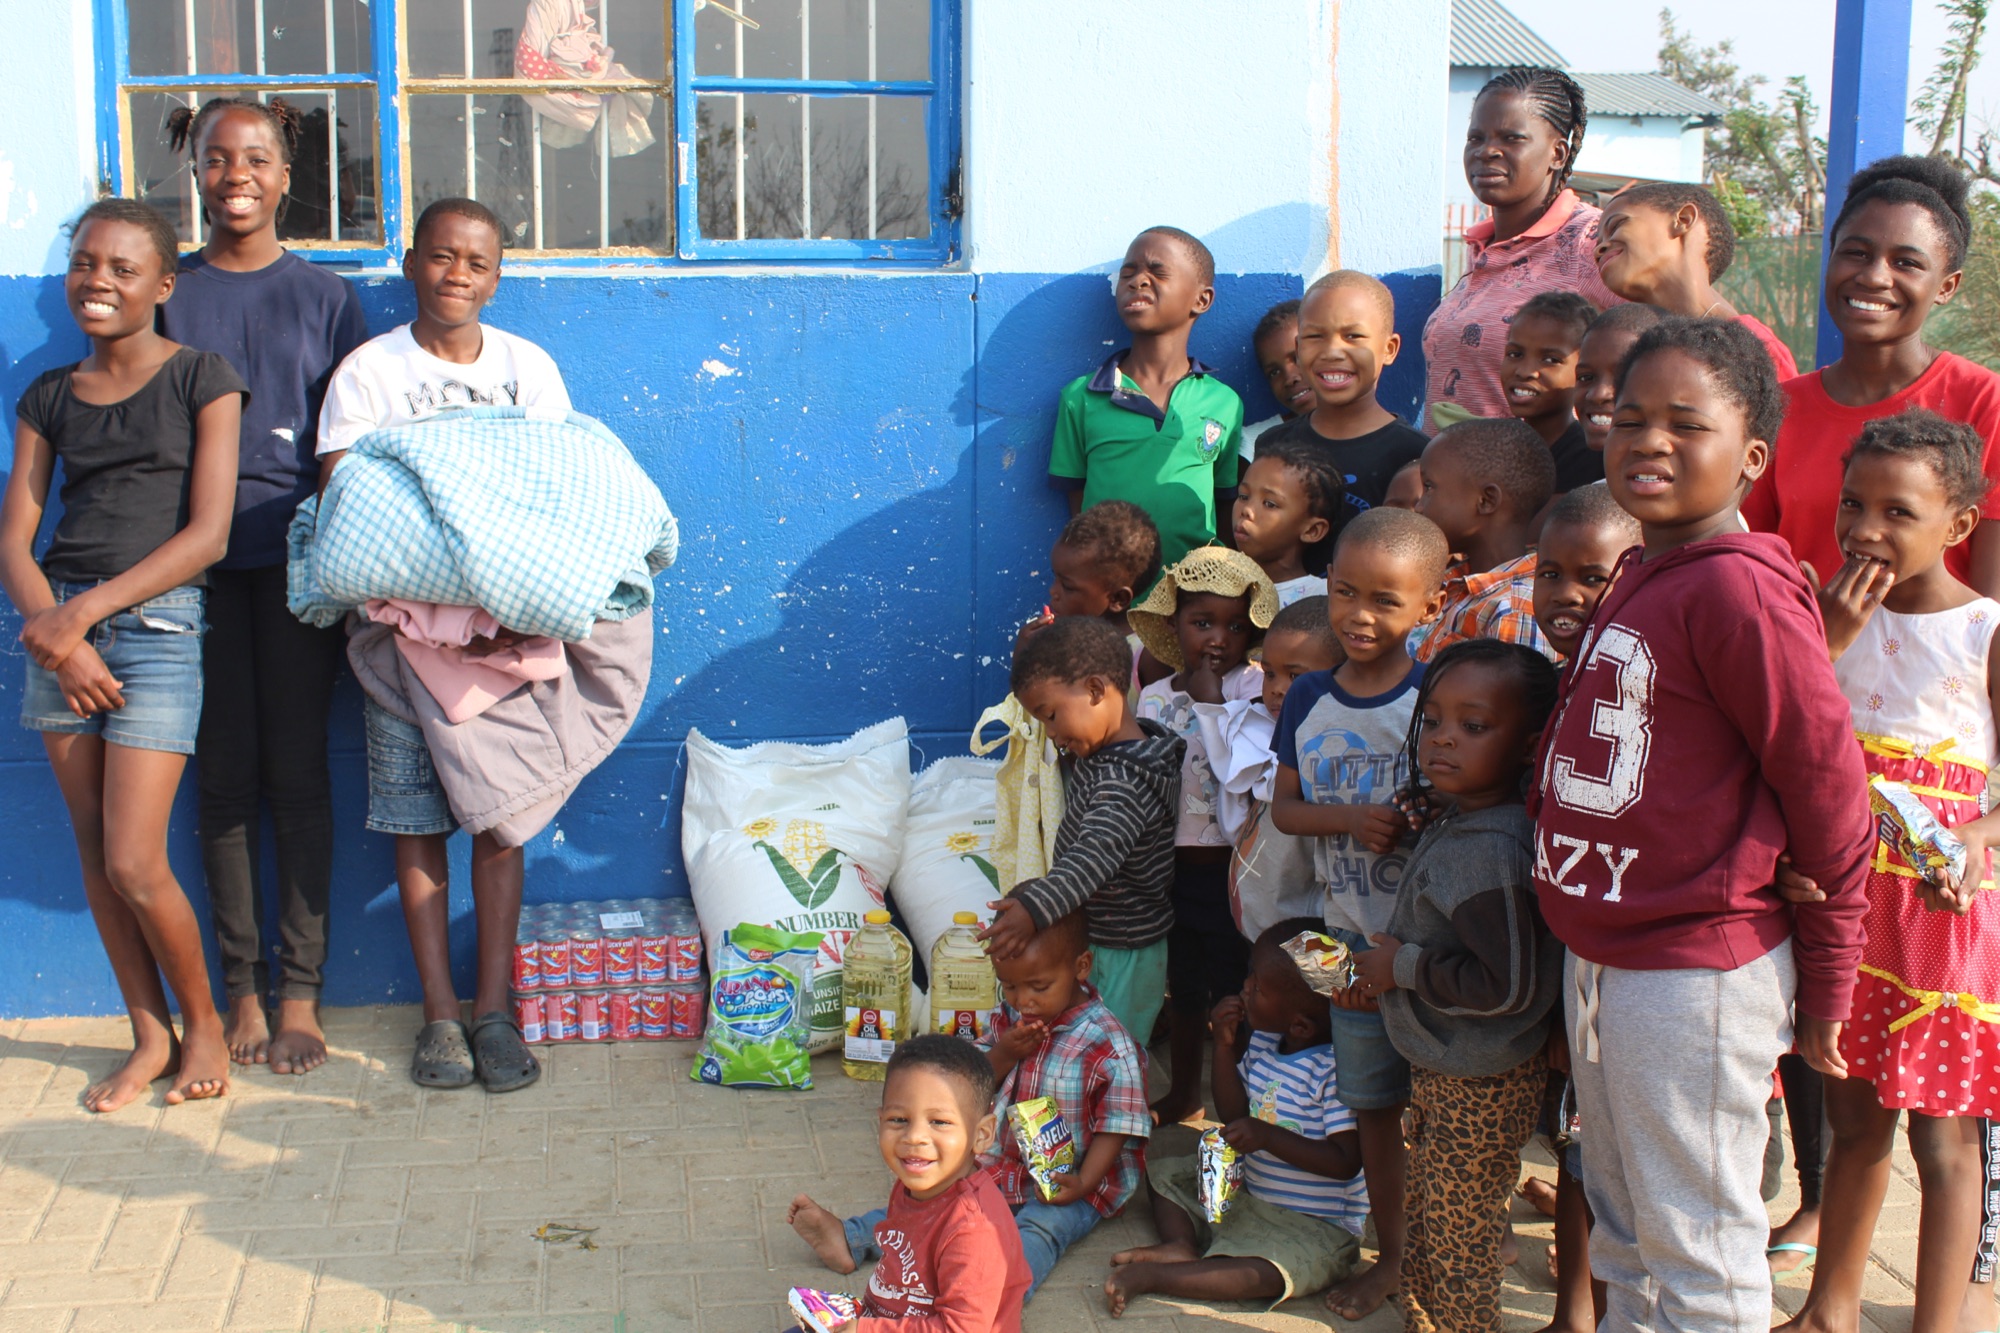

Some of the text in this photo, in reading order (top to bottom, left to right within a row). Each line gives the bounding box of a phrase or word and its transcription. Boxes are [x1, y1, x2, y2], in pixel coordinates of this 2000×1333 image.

[1541, 622, 1657, 820] 3
[1331, 854, 1407, 897] SHO
[1531, 826, 1640, 902] AZY
[774, 911, 860, 933] NUMBER
[813, 986, 843, 1000] UNSIF
[704, 1064, 718, 1077] 48
